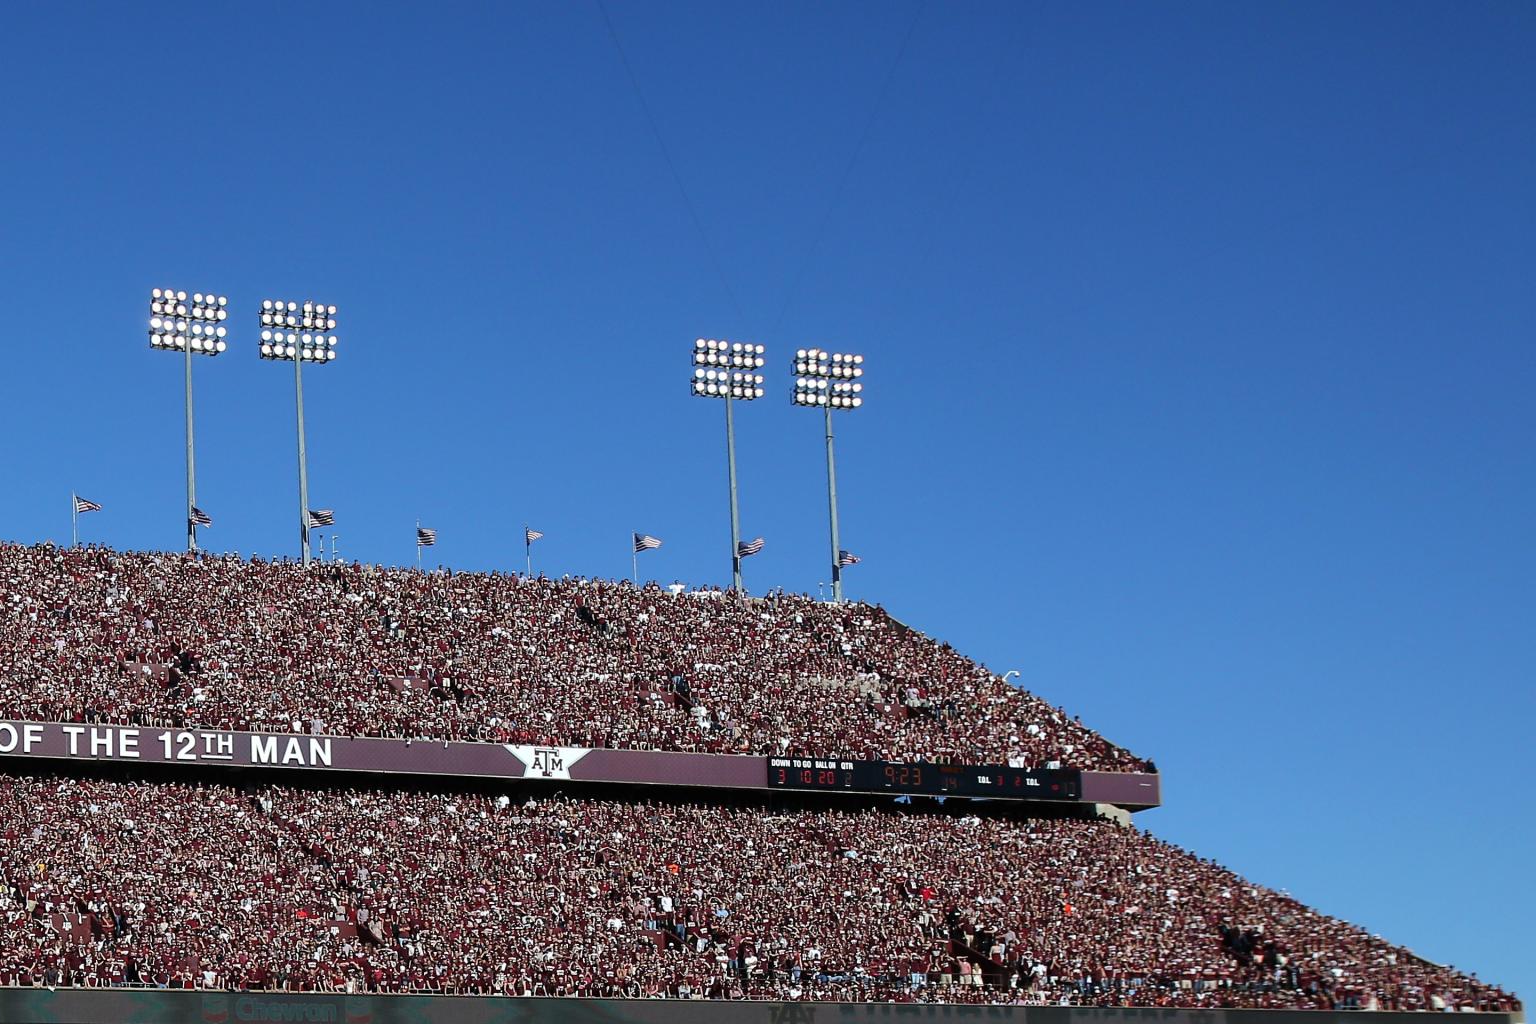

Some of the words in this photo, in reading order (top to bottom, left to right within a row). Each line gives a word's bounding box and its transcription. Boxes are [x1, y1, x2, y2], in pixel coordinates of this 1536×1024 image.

[63, 725, 140, 758] THE
[158, 730, 233, 760] 12TH
[251, 734, 332, 766] MAN
[771, 759, 791, 767] DOWN
[793, 759, 802, 768] TO
[802, 760, 812, 769] GO
[840, 761, 854, 770] QTR
[779, 769, 786, 783] 3
[800, 769, 812, 784] 10
[818, 770, 835, 785] 20
[885, 767, 921, 786] 9:23
[236, 997, 338, 1022] Chevron
